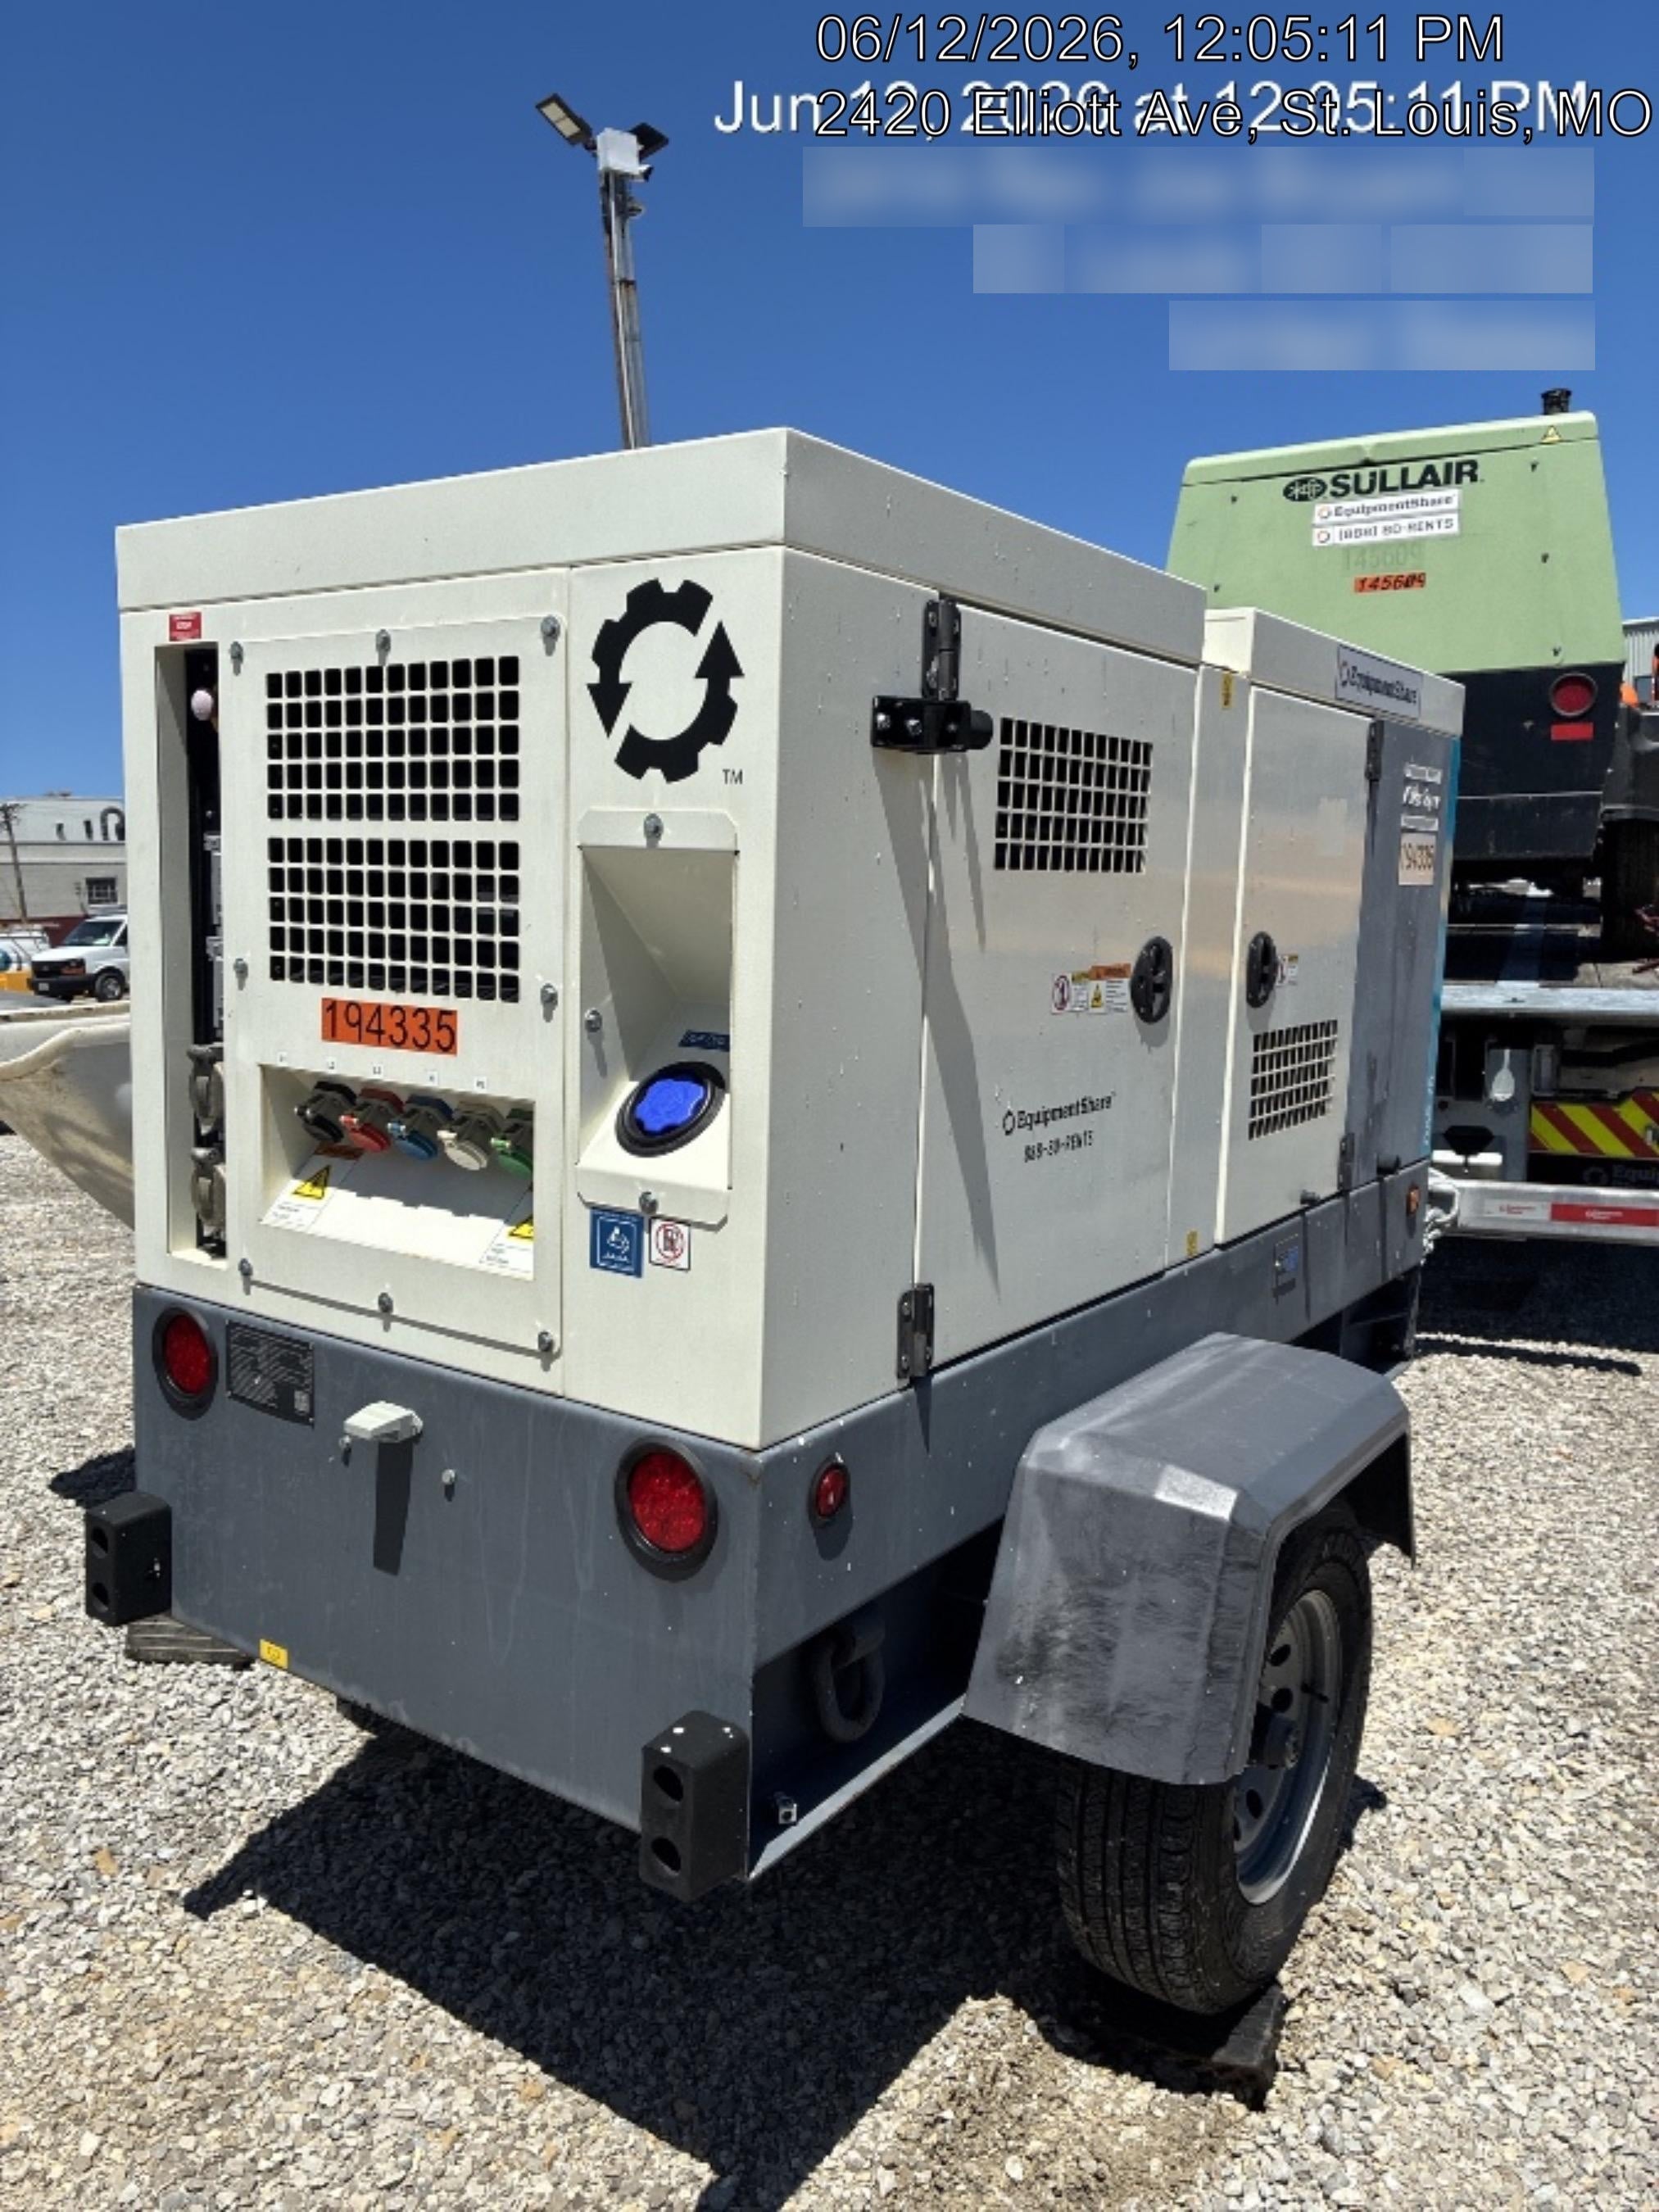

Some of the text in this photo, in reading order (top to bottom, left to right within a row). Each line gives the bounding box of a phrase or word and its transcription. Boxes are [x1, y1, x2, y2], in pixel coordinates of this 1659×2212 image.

[1330, 460, 1479, 497] SULLAIR
[1334, 494, 1455, 518] EquipmentShare
[723, 768, 743, 785] TM
[326, 999, 456, 1052] 194335
